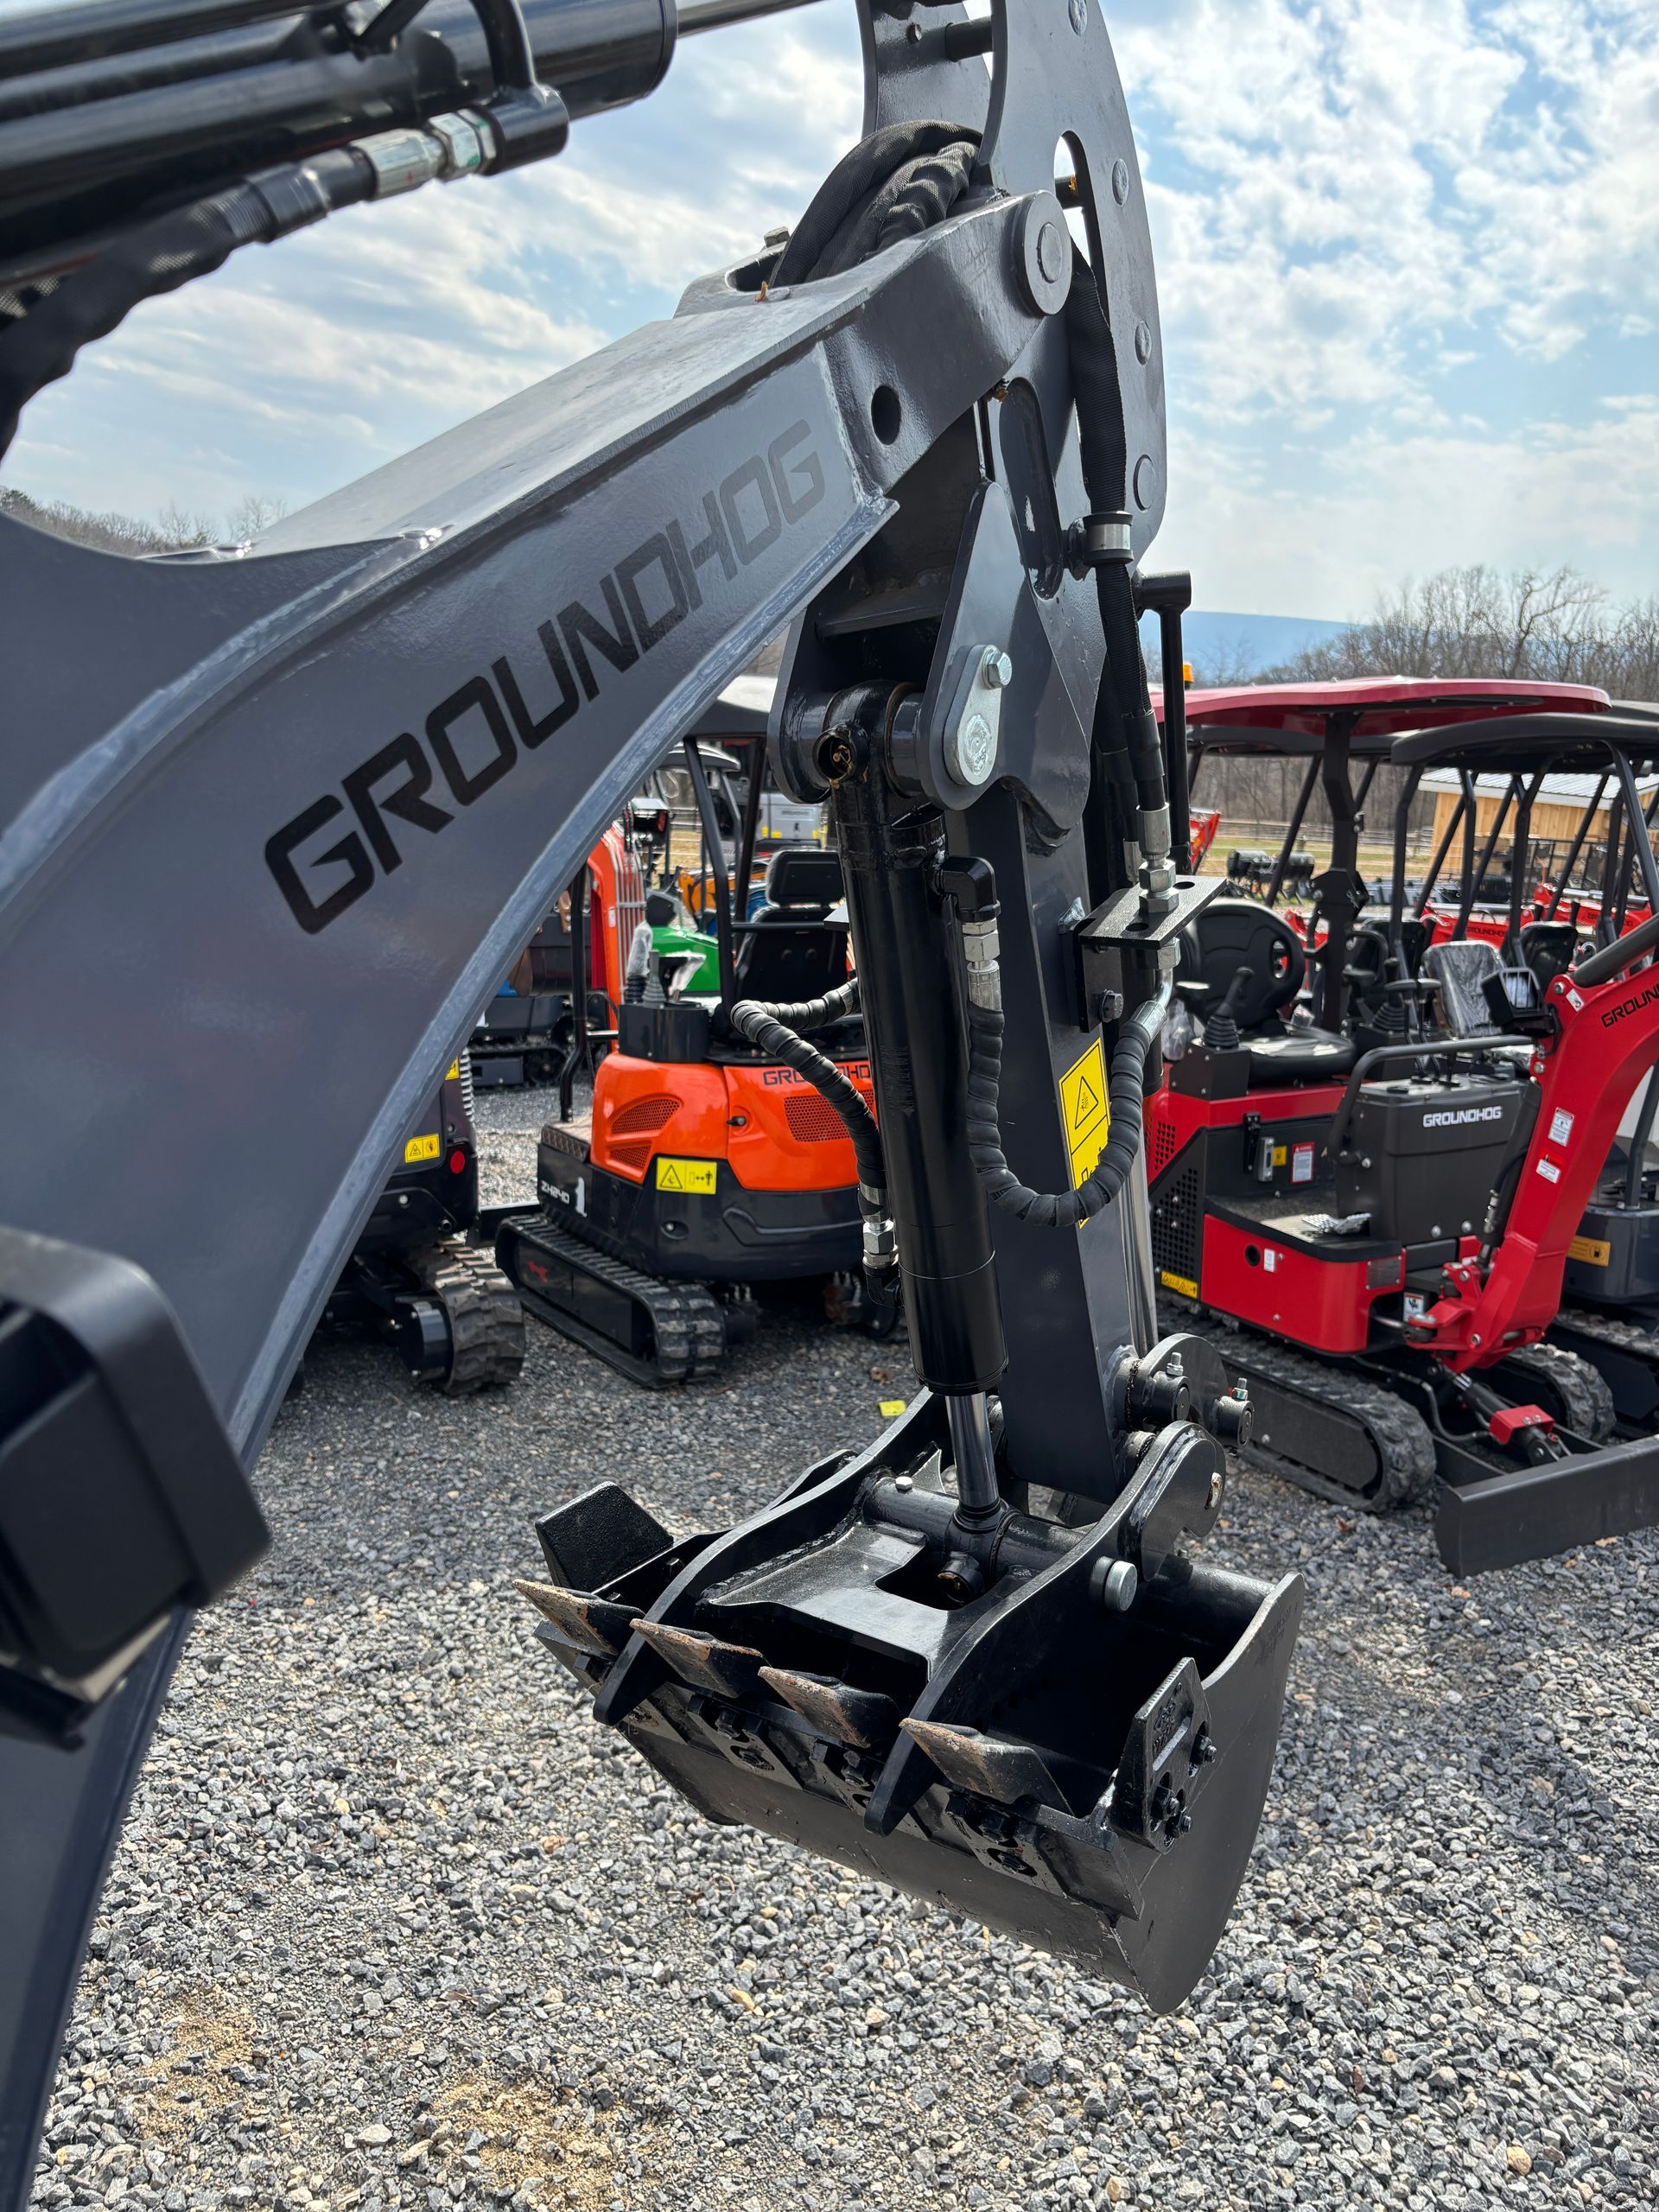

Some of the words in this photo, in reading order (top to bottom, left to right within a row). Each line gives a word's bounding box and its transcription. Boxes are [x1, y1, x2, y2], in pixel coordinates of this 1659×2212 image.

[264, 419, 825, 935] GROUNDHOG
[1601, 983, 1659, 1027] GROUN
[1423, 1106, 1502, 1128] GROUNDHOG
